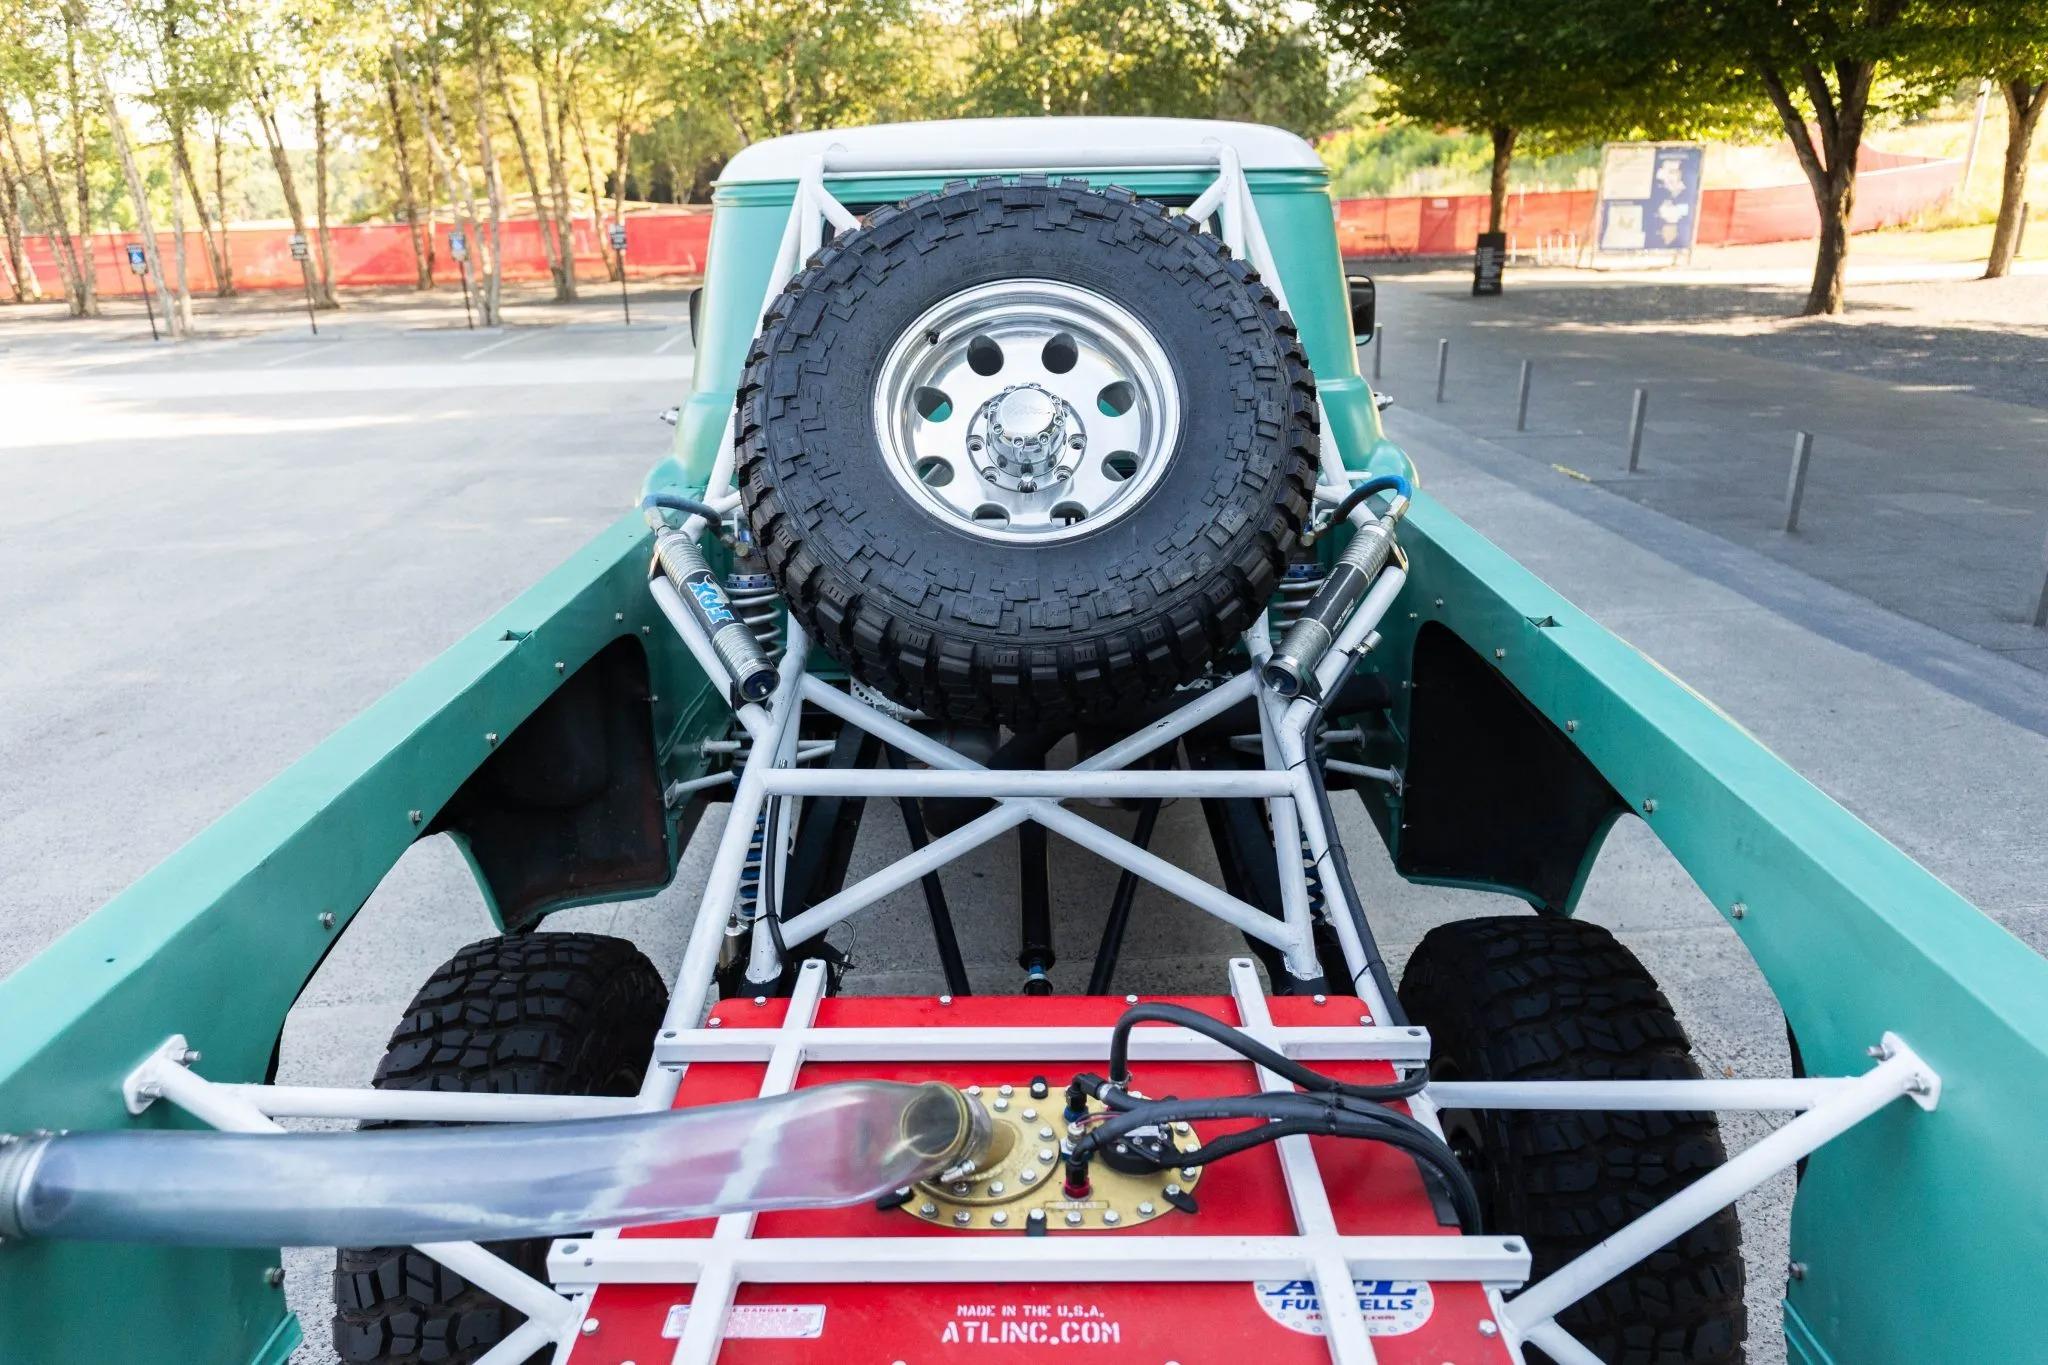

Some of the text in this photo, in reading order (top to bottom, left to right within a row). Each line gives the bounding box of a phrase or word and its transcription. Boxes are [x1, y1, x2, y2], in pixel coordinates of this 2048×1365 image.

[687, 575, 735, 625] FOX
[957, 1305, 1105, 1318] MADE IN THE U.S.A.
[1281, 1299, 1414, 1310] FUE ELLS
[941, 1321, 1121, 1345] ATLINC.COM
